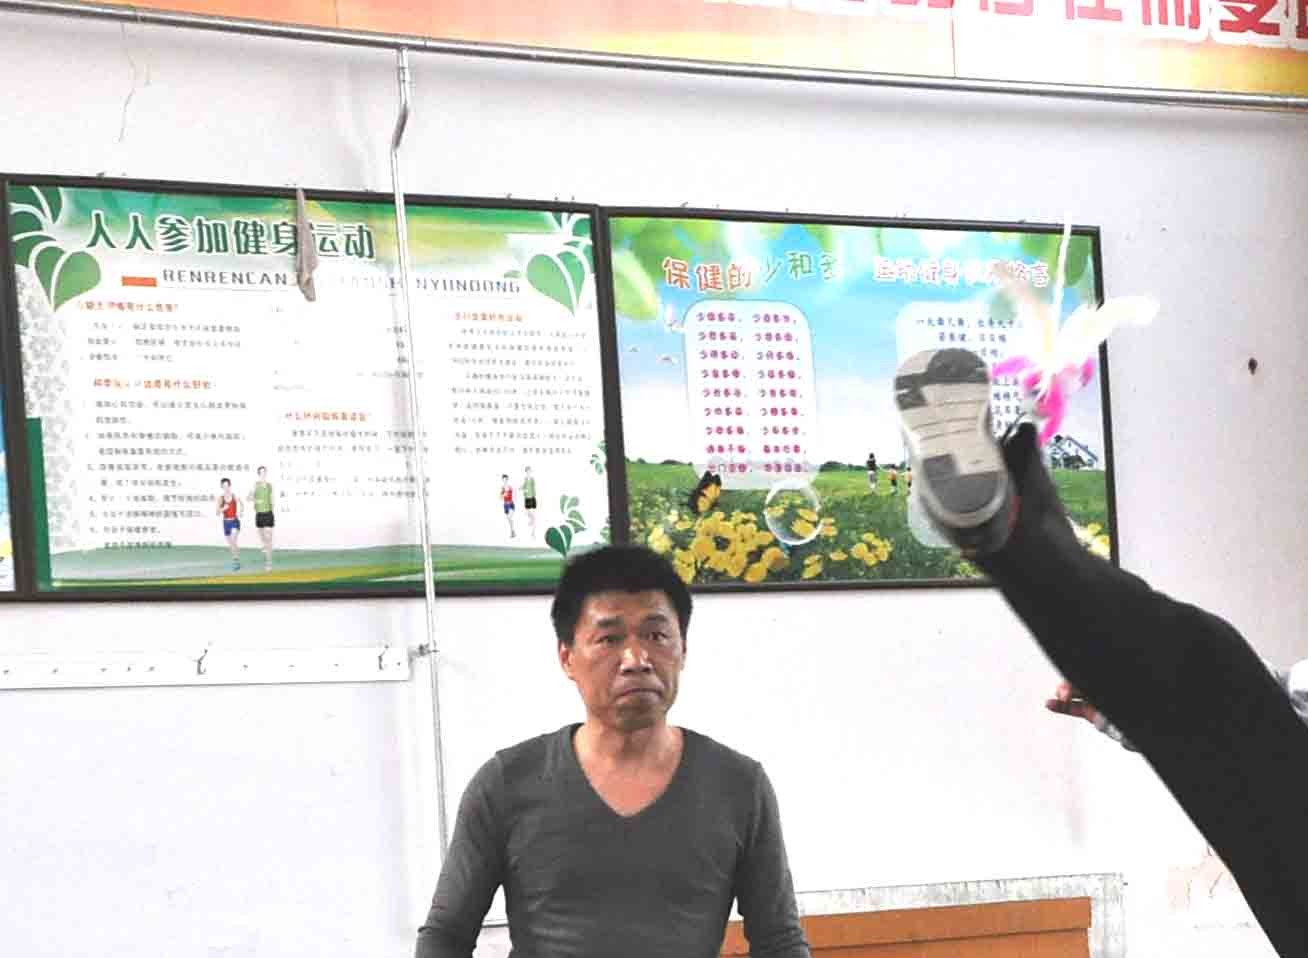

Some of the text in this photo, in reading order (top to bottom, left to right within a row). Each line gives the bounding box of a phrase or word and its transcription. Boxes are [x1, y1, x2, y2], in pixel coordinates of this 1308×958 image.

[85, 212, 376, 260] 人人参加健身运动
